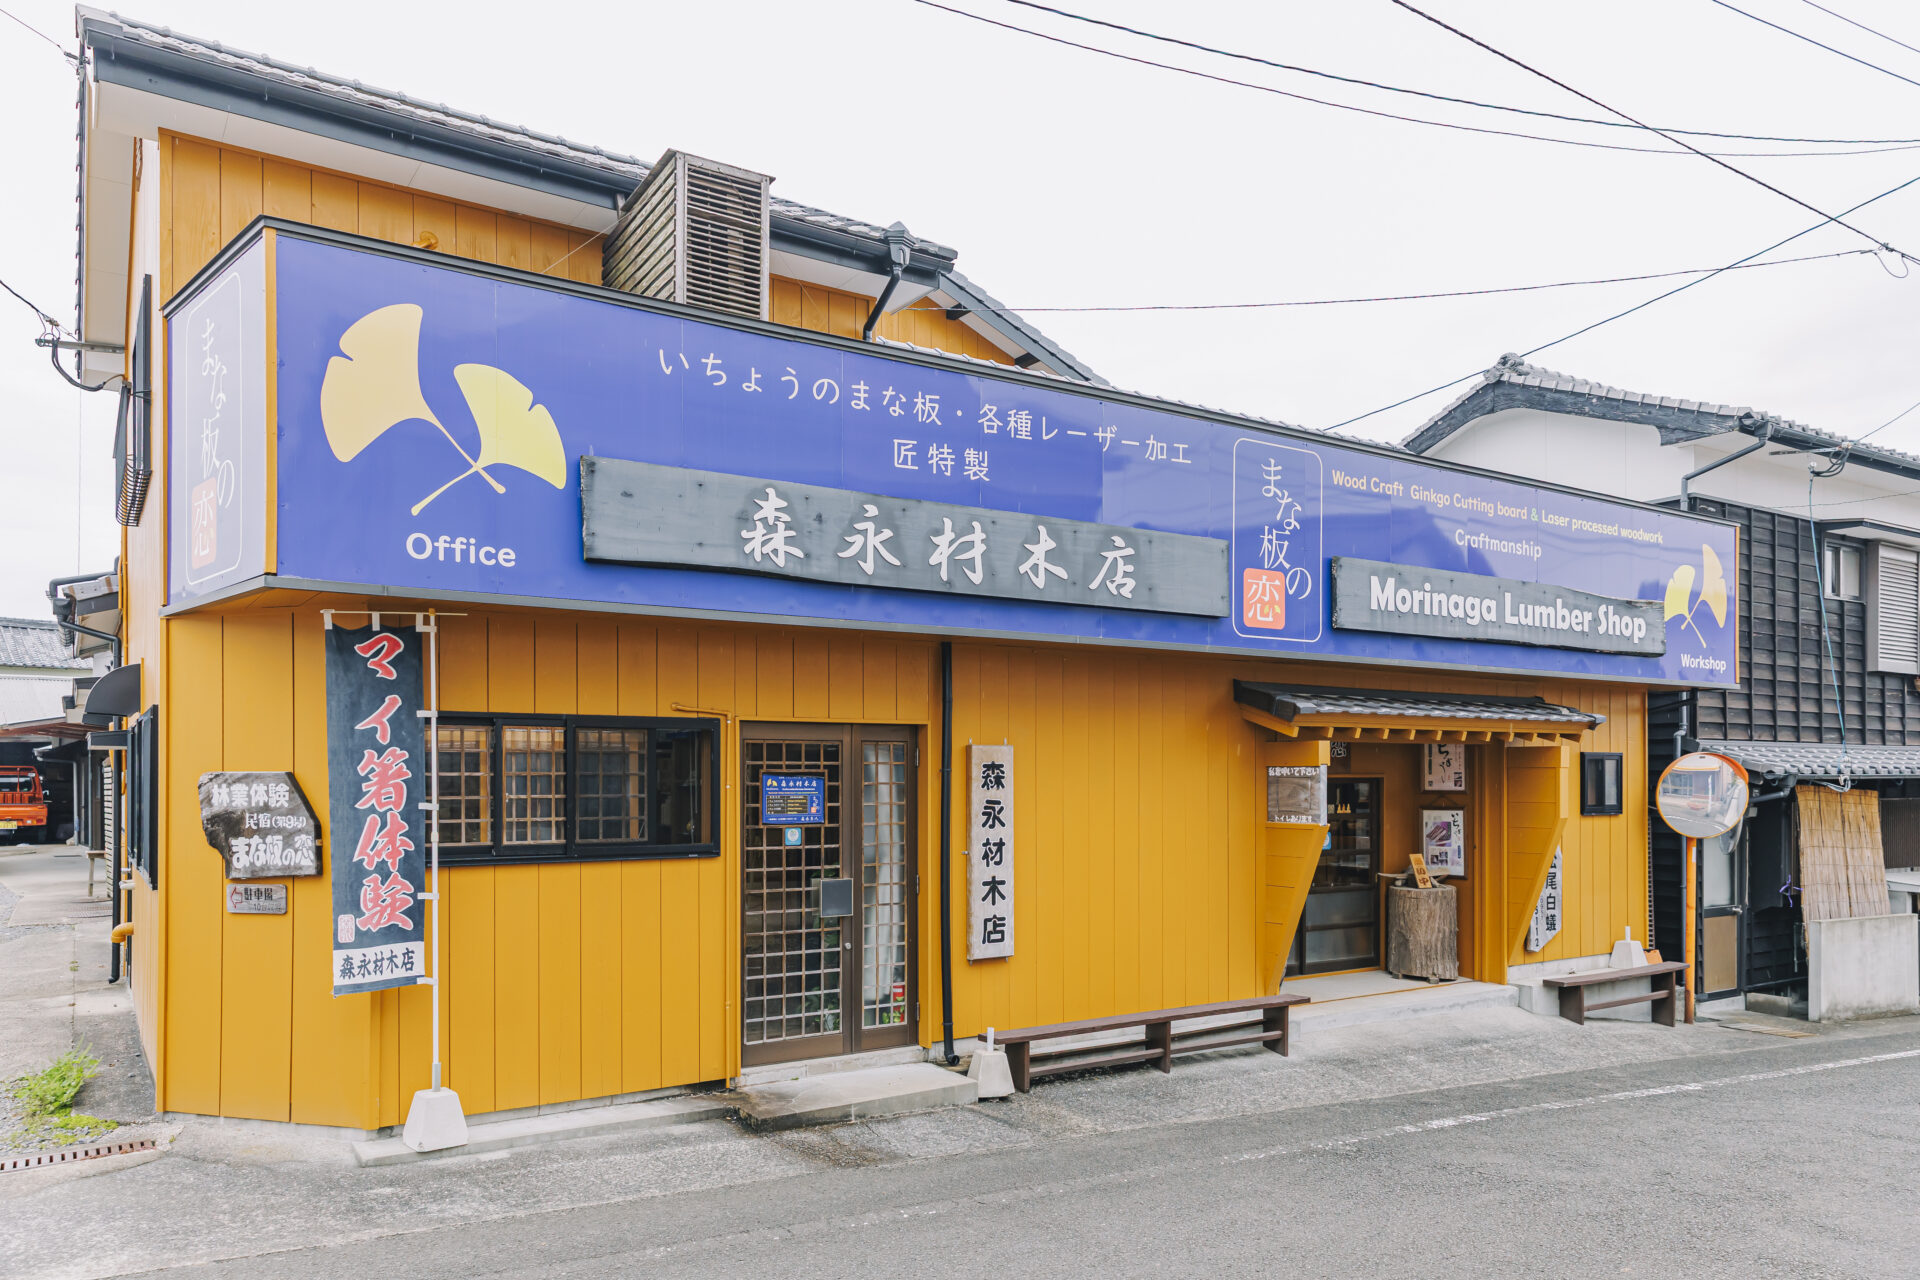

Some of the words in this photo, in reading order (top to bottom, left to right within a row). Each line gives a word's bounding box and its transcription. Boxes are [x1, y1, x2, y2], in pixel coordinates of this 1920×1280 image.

[658, 347, 1193, 465] いちょうのまな板・各種レーザー加工
[892, 438, 991, 482] 匠特製
[1332, 469, 1367, 490] Wood
[1370, 478, 1404, 497] Craft
[1410, 485, 1451, 507] Ginkgo
[1453, 493, 1495, 517] Cutting
[1497, 501, 1528, 520] board
[1530, 507, 1539, 522] &
[1541, 510, 1570, 527] Laser
[1572, 517, 1619, 537] processed
[1620, 524, 1664, 545] woodwork
[405, 531, 517, 568] Office
[740, 487, 1138, 600] 森永材木店
[1455, 529, 1542, 561] Craftmanship
[1370, 575, 1497, 626] Morinaga
[1504, 592, 1593, 633] Lumber
[1597, 604, 1647, 644] Shop
[1681, 653, 1727, 673] Workshop
[212, 782, 290, 808] 林業体験
[353, 631, 415, 932] マイ箸体験
[231, 834, 314, 868] まな板の恋
[981, 761, 1006, 945] 森永材木店
[339, 947, 415, 980] 森永材木店
